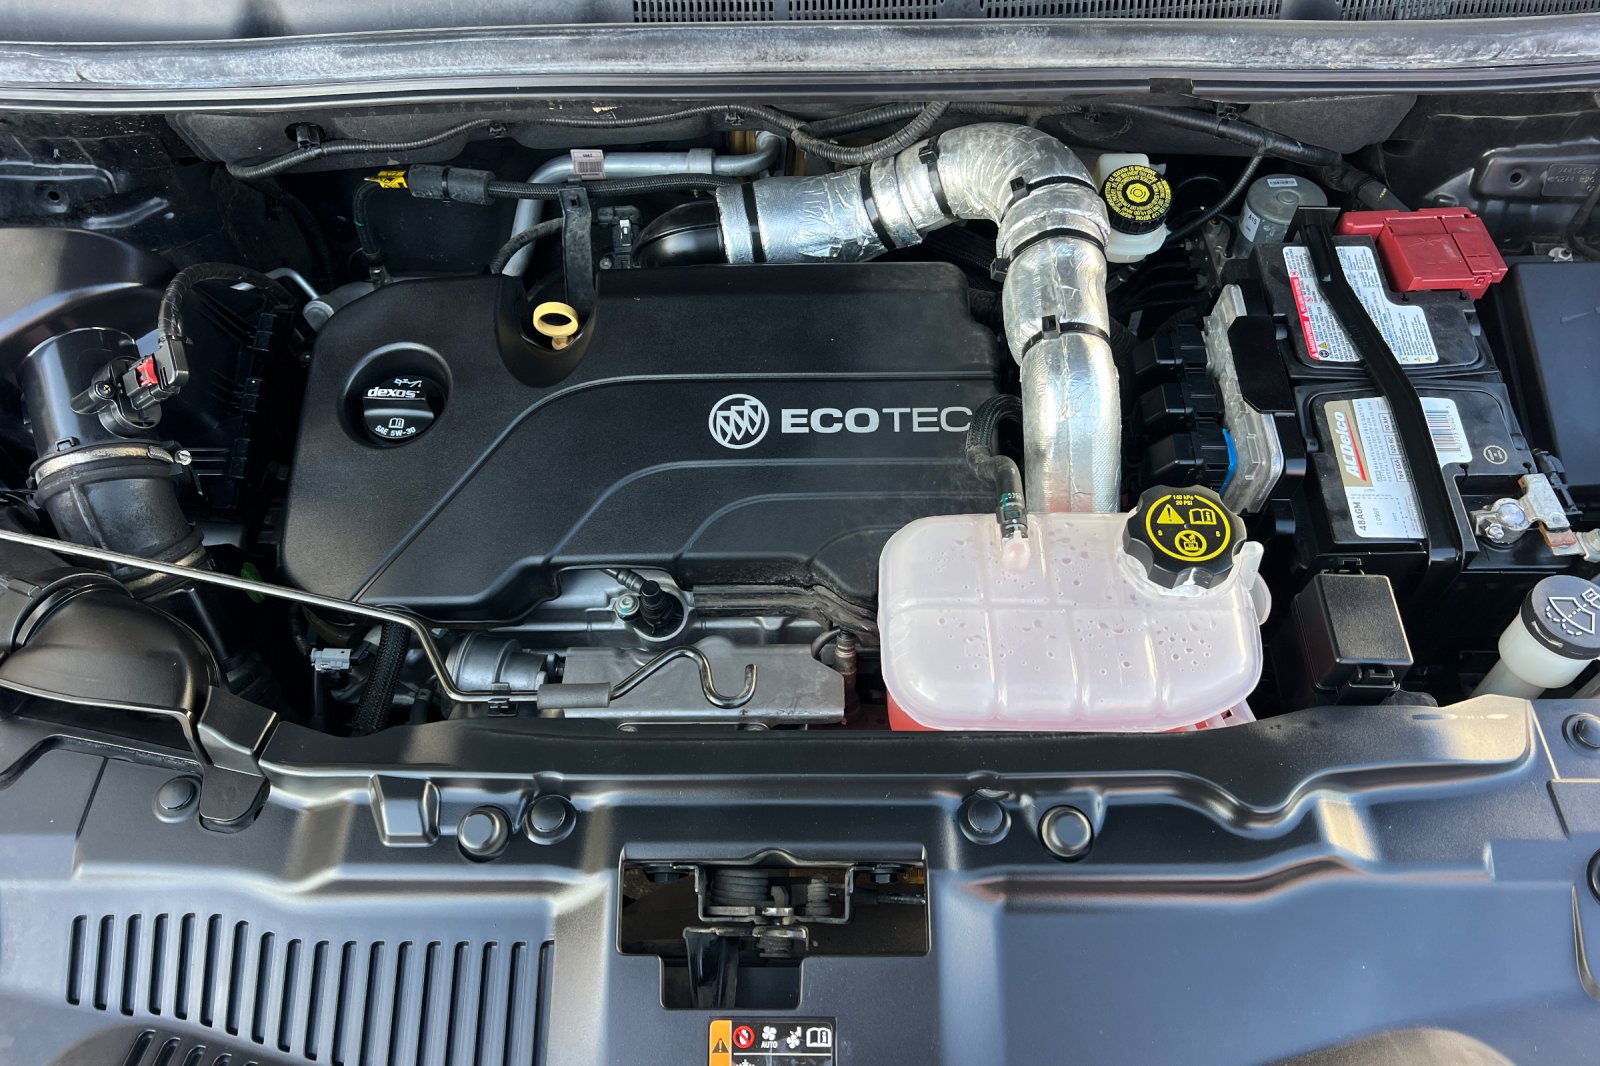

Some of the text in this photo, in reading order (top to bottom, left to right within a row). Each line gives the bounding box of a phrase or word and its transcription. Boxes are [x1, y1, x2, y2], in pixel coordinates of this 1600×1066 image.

[367, 386, 417, 398] dexos
[781, 406, 973, 433] ECOTEC
[375, 425, 416, 437] SAE 5W-30
[1334, 411, 1360, 478] ACDelco
[1353, 501, 1367, 531] 48AGM
[761, 1041, 778, 1049] AUTO
